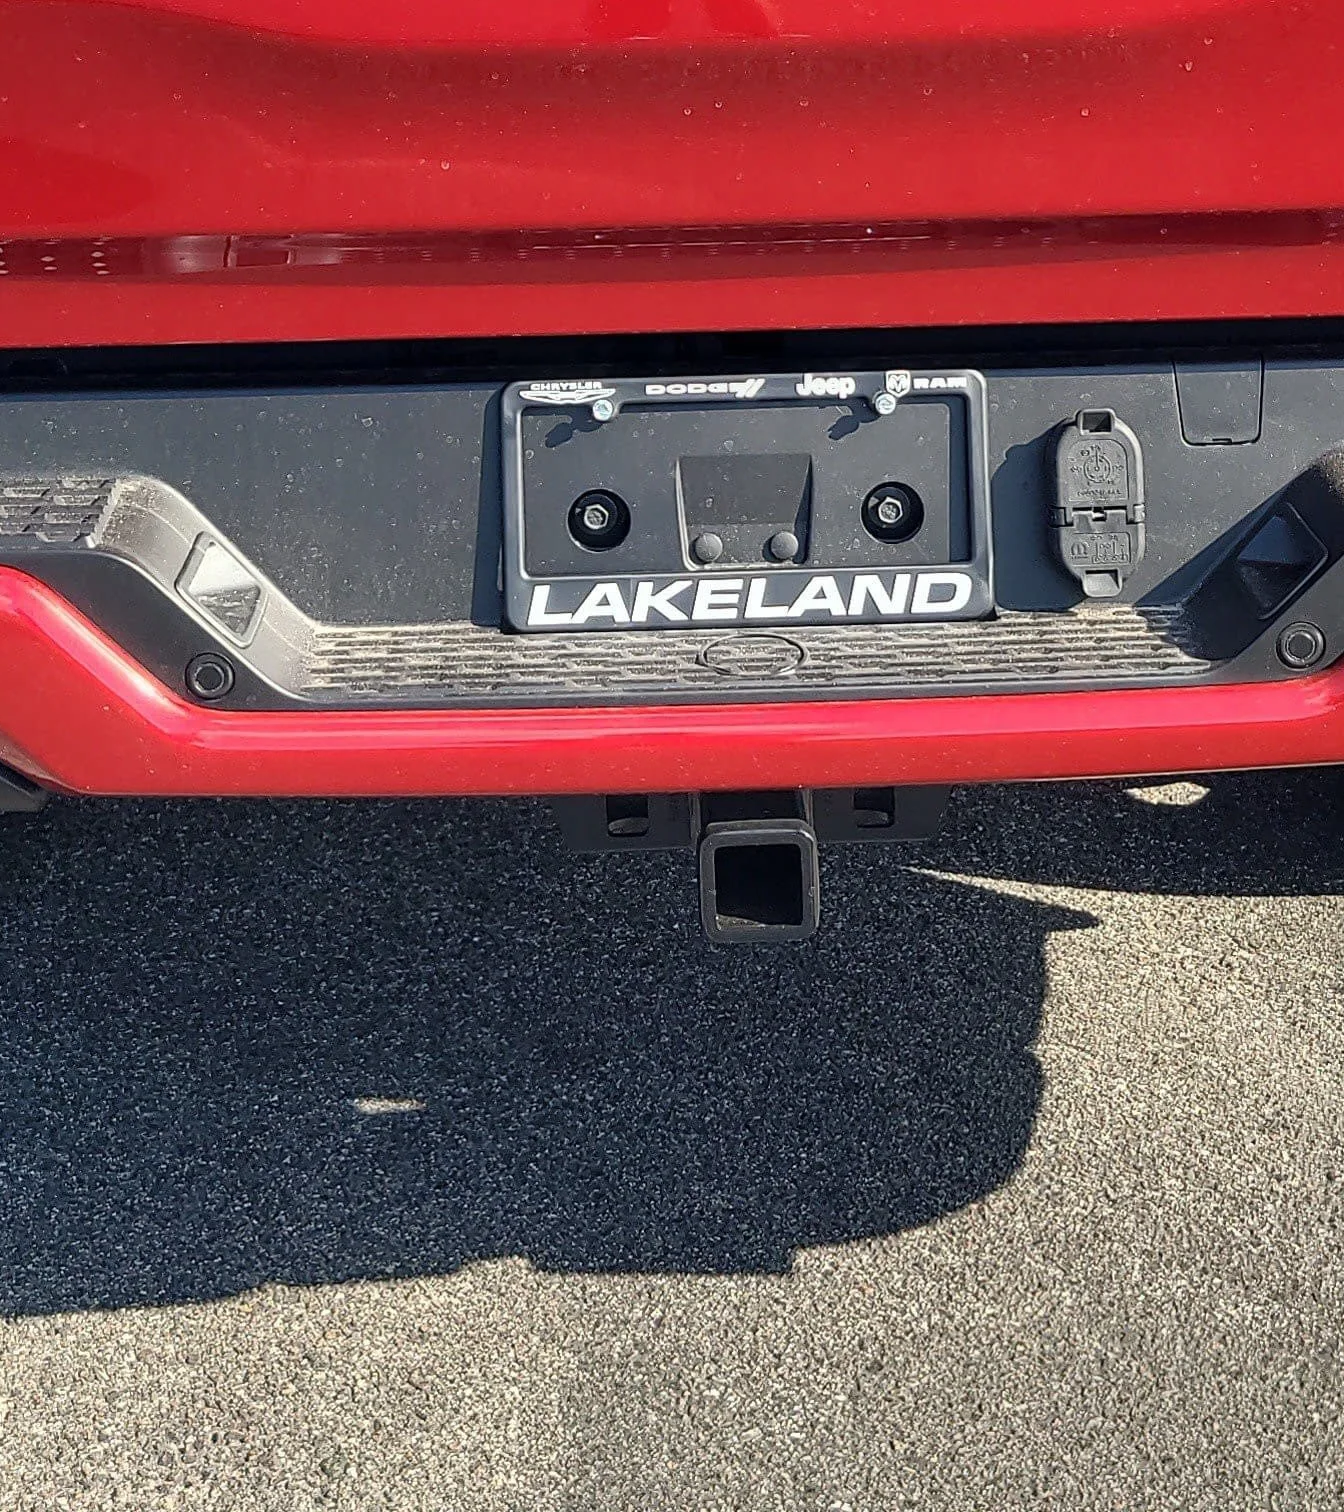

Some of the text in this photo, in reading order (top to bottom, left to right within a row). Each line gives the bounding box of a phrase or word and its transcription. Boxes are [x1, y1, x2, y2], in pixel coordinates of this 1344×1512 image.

[530, 373, 968, 399] CHRYSLER DODGE Jeep RAM
[526, 572, 972, 626] LAKELAND
